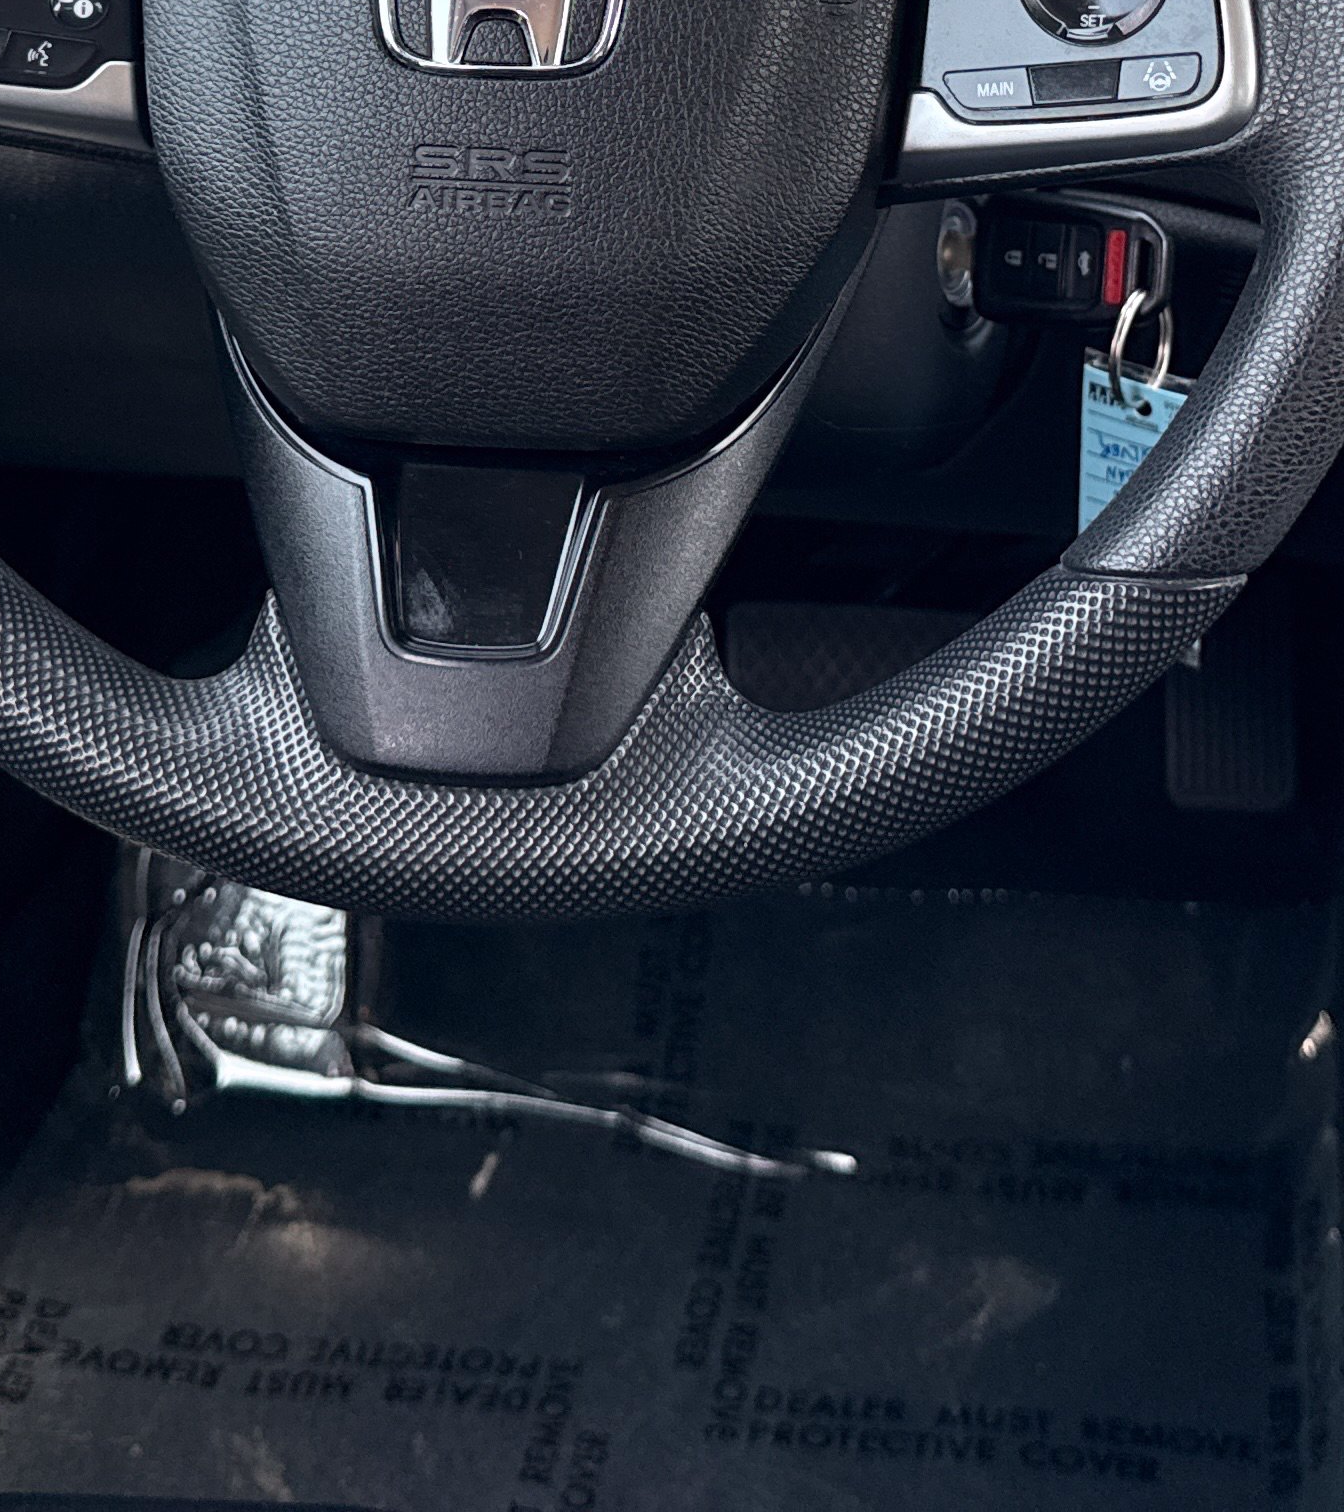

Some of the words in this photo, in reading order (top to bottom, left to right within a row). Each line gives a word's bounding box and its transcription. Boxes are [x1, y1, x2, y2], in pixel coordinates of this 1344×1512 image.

[1080, 13, 1107, 29] SET
[976, 81, 1015, 98] MAIN
[413, 143, 569, 182] SRS
[408, 187, 573, 215] AIRBAG
